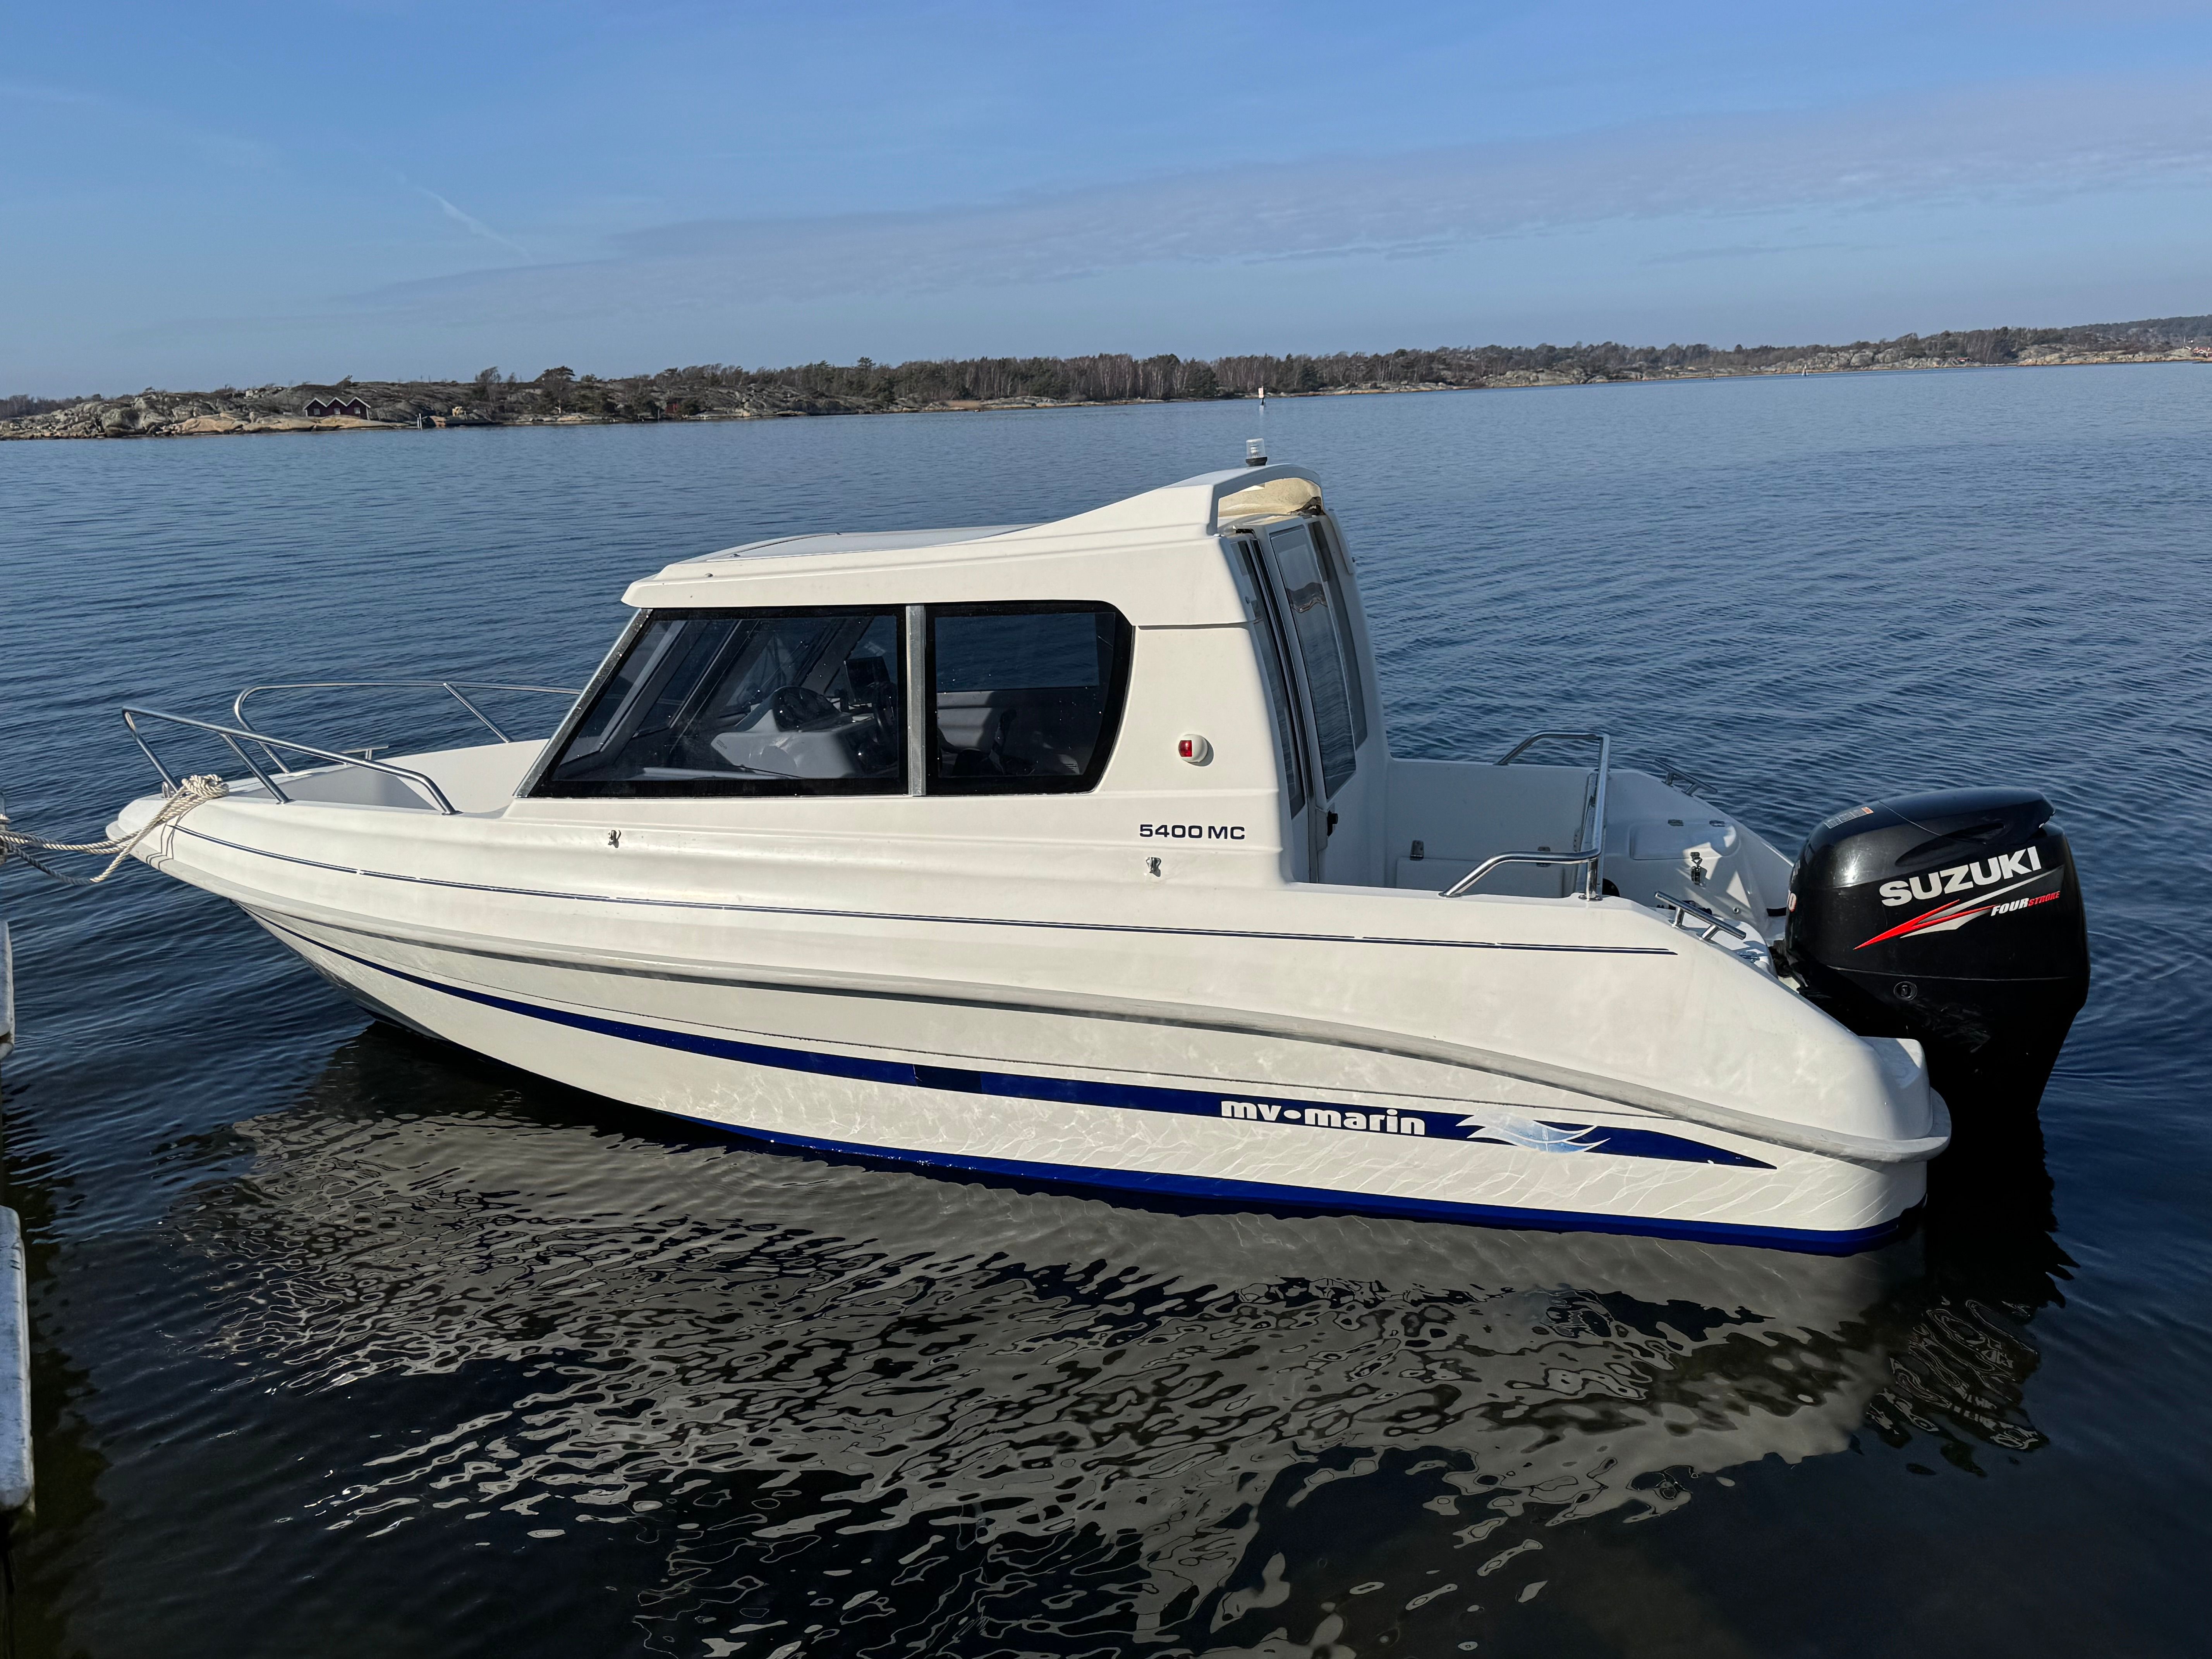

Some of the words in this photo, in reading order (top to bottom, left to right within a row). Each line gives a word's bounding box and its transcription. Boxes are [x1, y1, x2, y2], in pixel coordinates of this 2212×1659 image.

[1140, 824, 1202, 838] 5400
[1208, 826, 1245, 840] MC
[1879, 846, 2042, 906] SUZUKI
